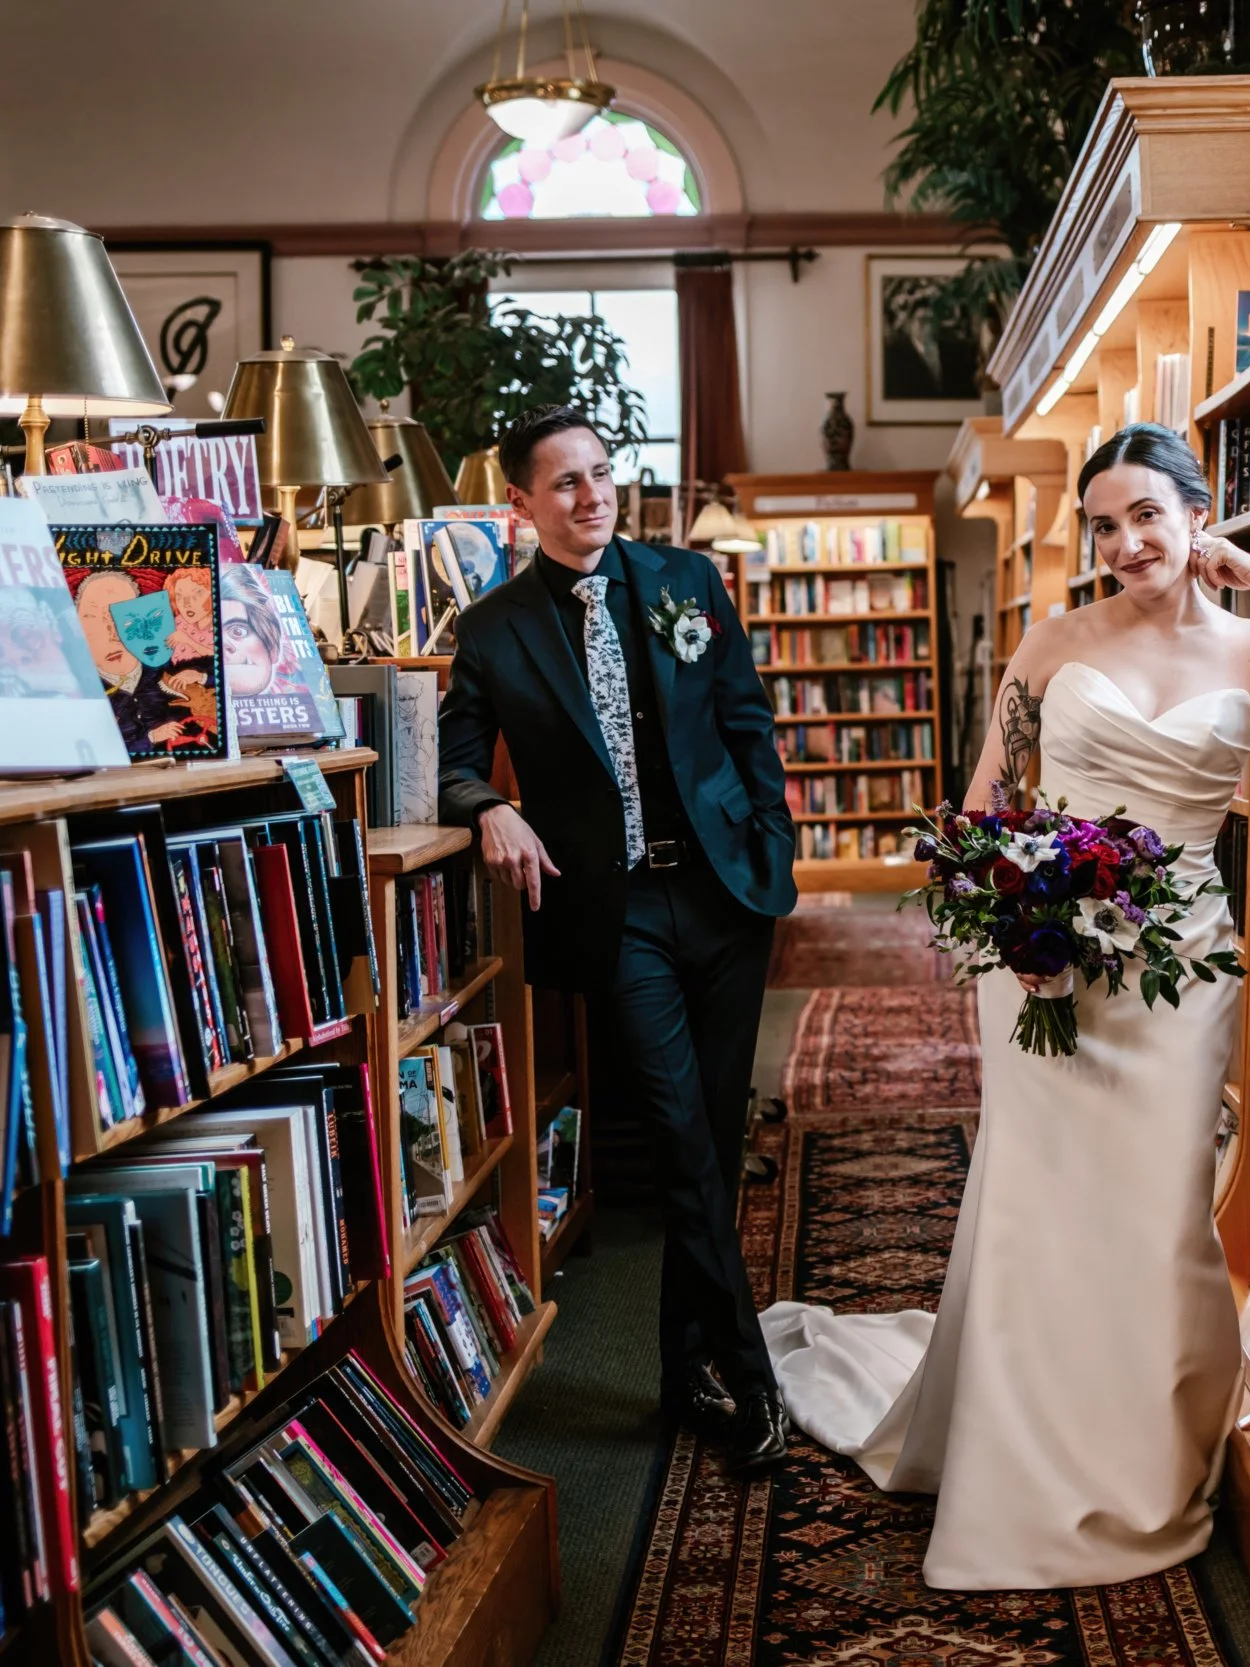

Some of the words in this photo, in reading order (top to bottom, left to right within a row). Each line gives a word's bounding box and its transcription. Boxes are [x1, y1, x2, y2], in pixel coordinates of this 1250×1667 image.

[257, 697, 287, 707] THING
[289, 697, 299, 705] IS
[339, 1219, 349, 1266] MOHAMED
[240, 1536, 313, 1630] UNFLATTENING
